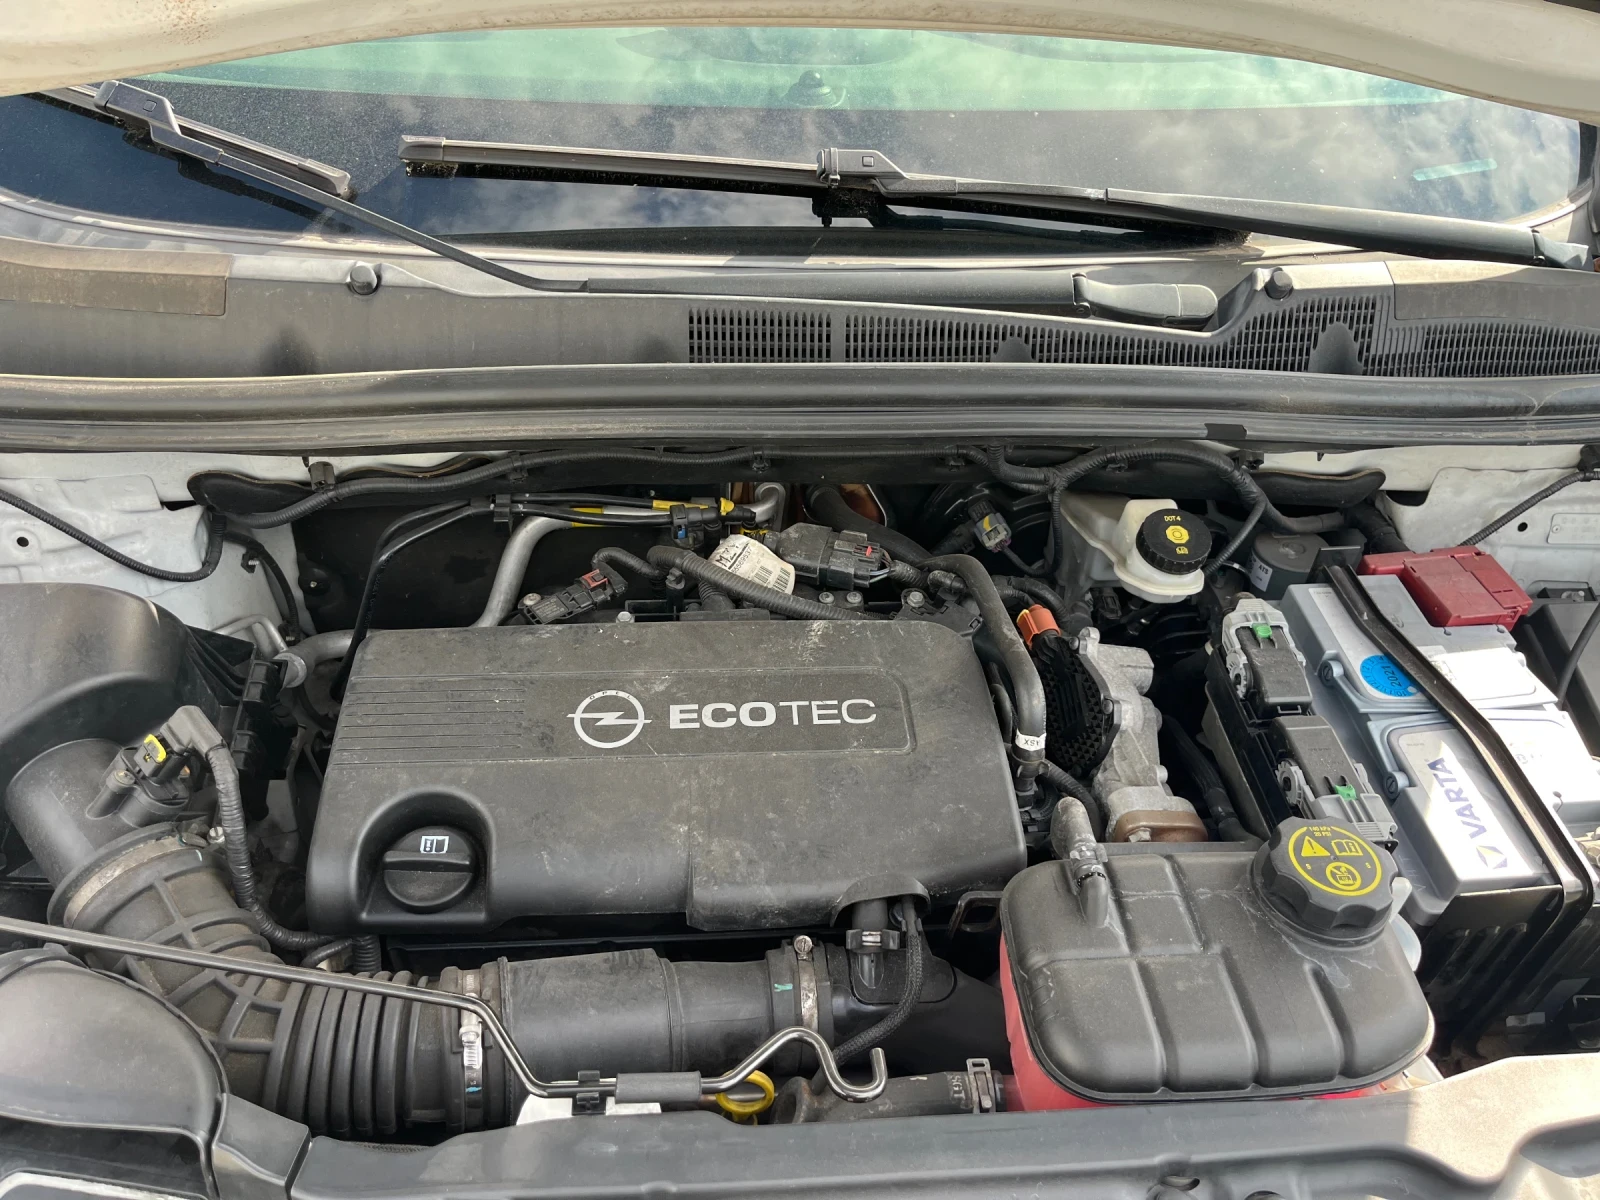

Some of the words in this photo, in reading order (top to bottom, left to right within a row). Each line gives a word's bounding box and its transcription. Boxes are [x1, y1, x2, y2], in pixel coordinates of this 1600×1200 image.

[1381, 665, 1402, 687] 2021
[589, 690, 631, 700] OPEL
[669, 698, 877, 729] ECOTEC
[1427, 757, 1487, 839] VARTA
